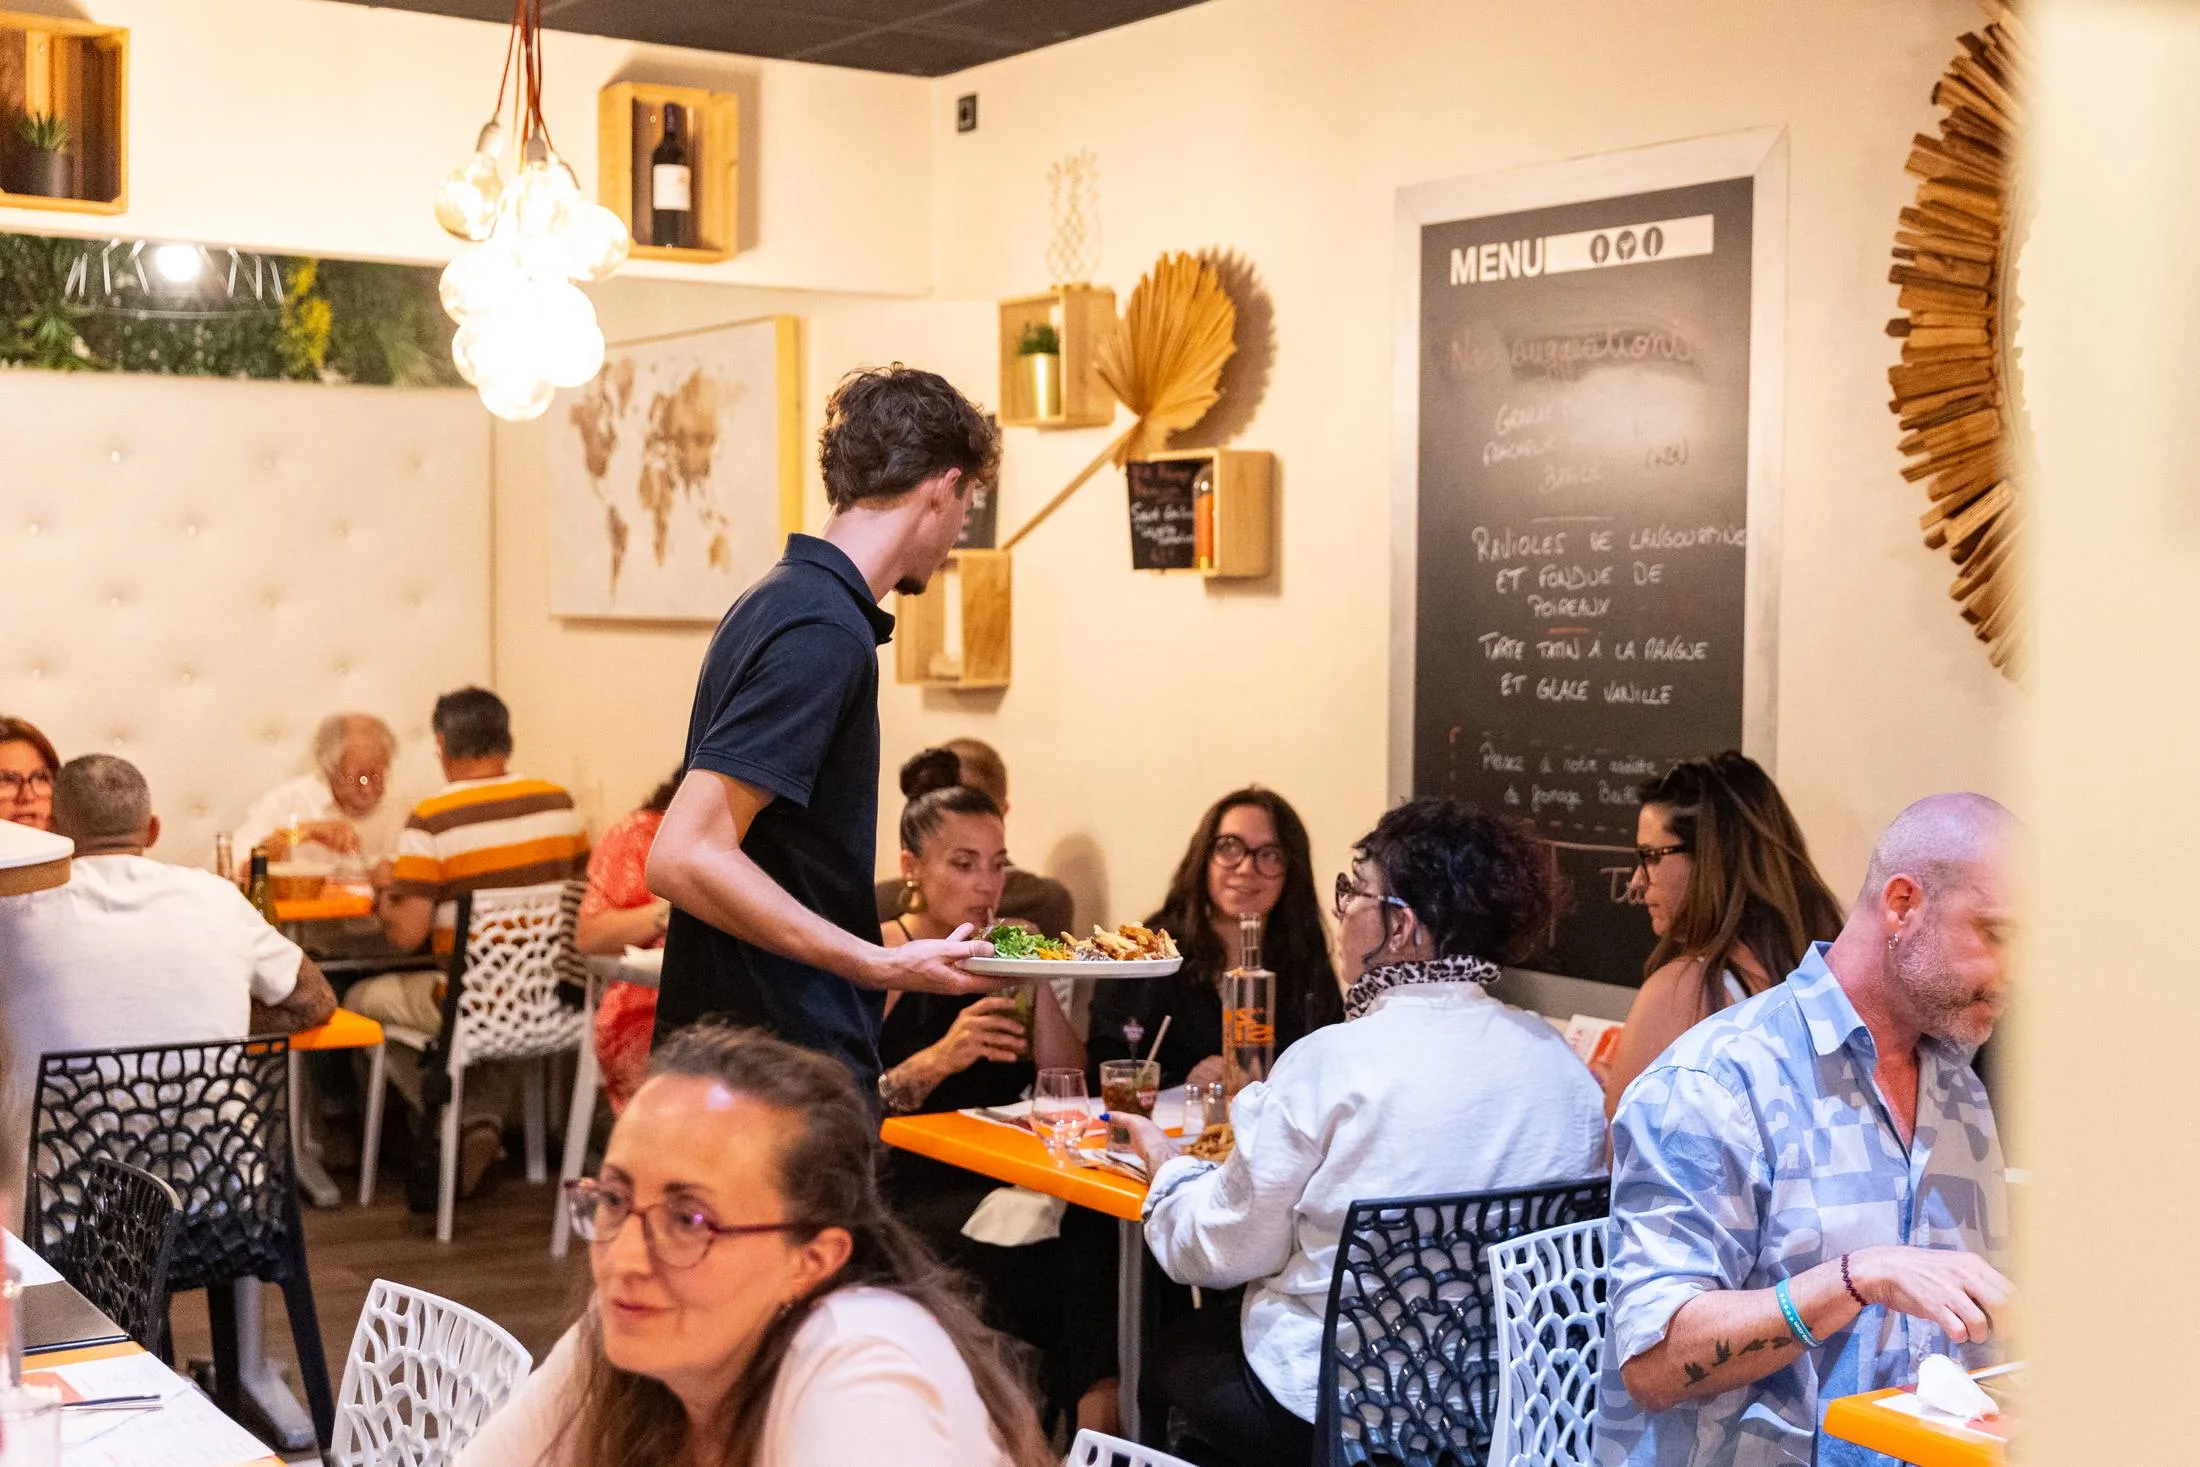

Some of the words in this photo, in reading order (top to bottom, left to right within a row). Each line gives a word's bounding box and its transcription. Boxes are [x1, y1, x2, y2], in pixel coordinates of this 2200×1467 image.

[1450, 236, 1545, 286] MENU
[1471, 525, 1568, 563] RAVIOLES
[1590, 530, 1614, 552] DE
[1495, 565, 1529, 595] ET
[1538, 563, 1615, 591] FONDUE
[1633, 560, 1665, 587] DE
[1615, 639, 1636, 661] LA
[1500, 671, 1528, 697] ET
[1536, 676, 1590, 702] GLACE
